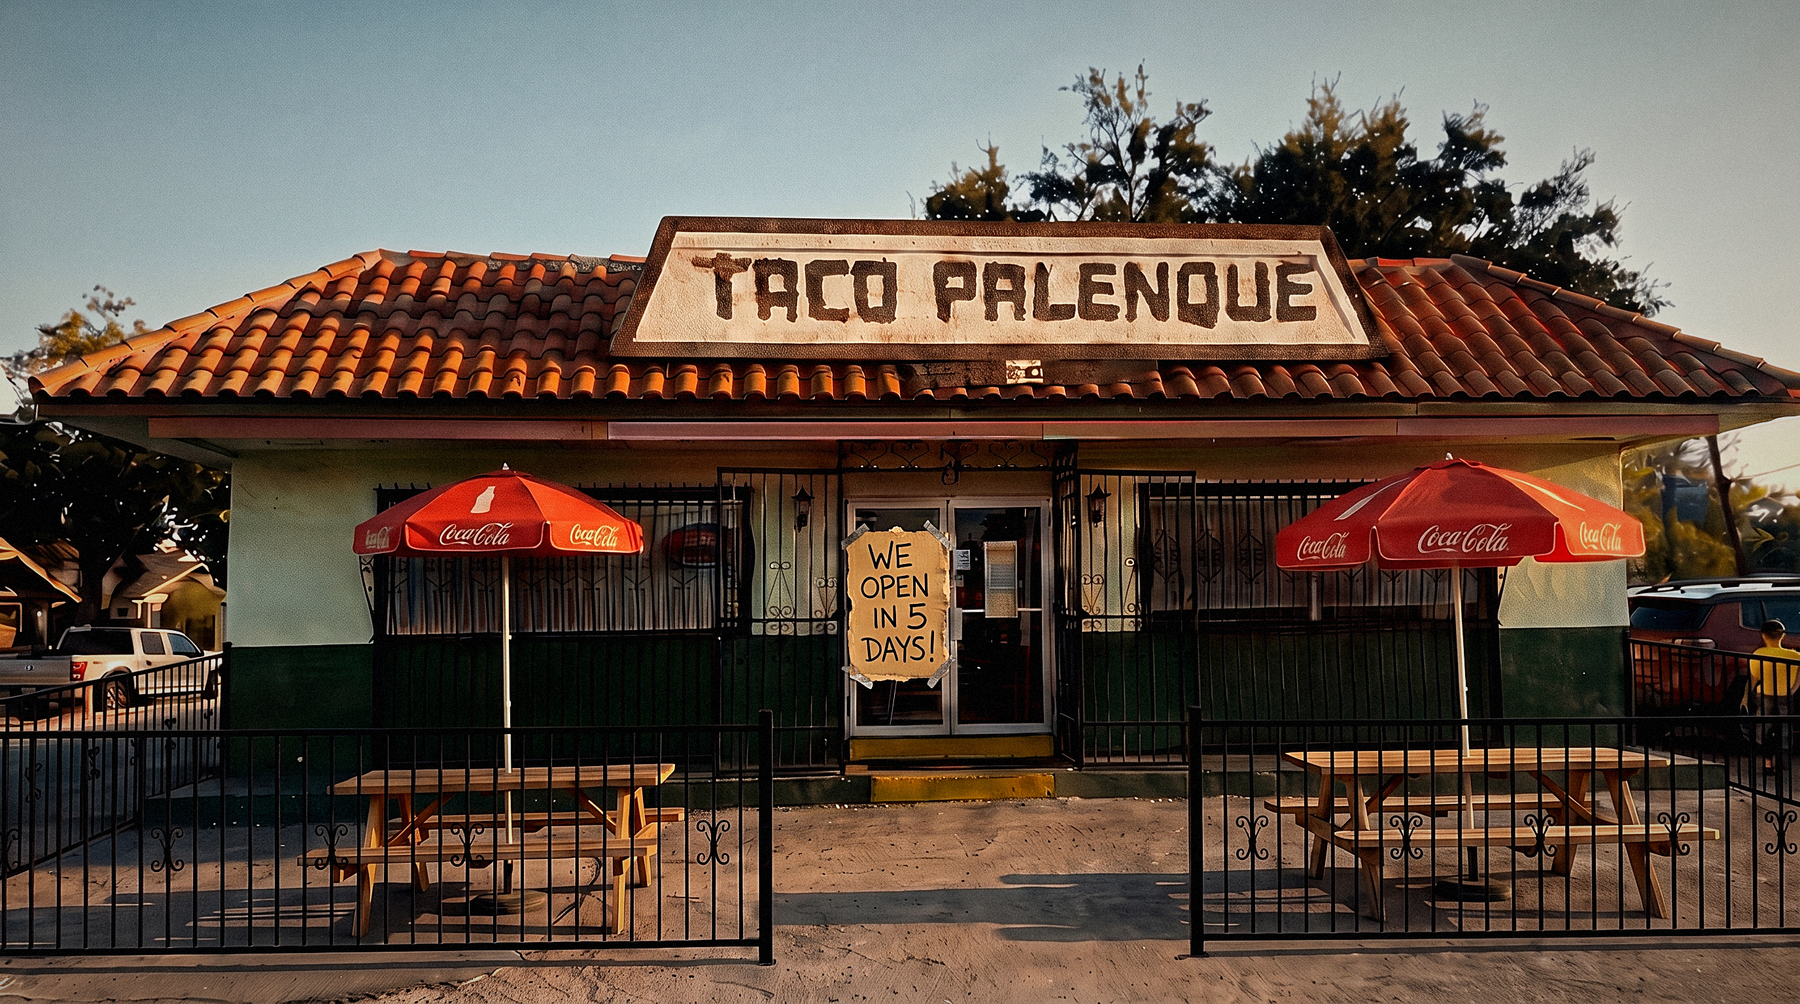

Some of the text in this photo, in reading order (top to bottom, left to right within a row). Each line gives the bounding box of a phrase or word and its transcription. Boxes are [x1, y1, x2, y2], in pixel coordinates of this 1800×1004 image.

[692, 252, 1317, 329] TACO PALENQUE
[867, 540, 913, 570] WE
[860, 572, 929, 600] OPEN
[873, 602, 928, 630] IN 5
[860, 630, 935, 664] DAYS!
